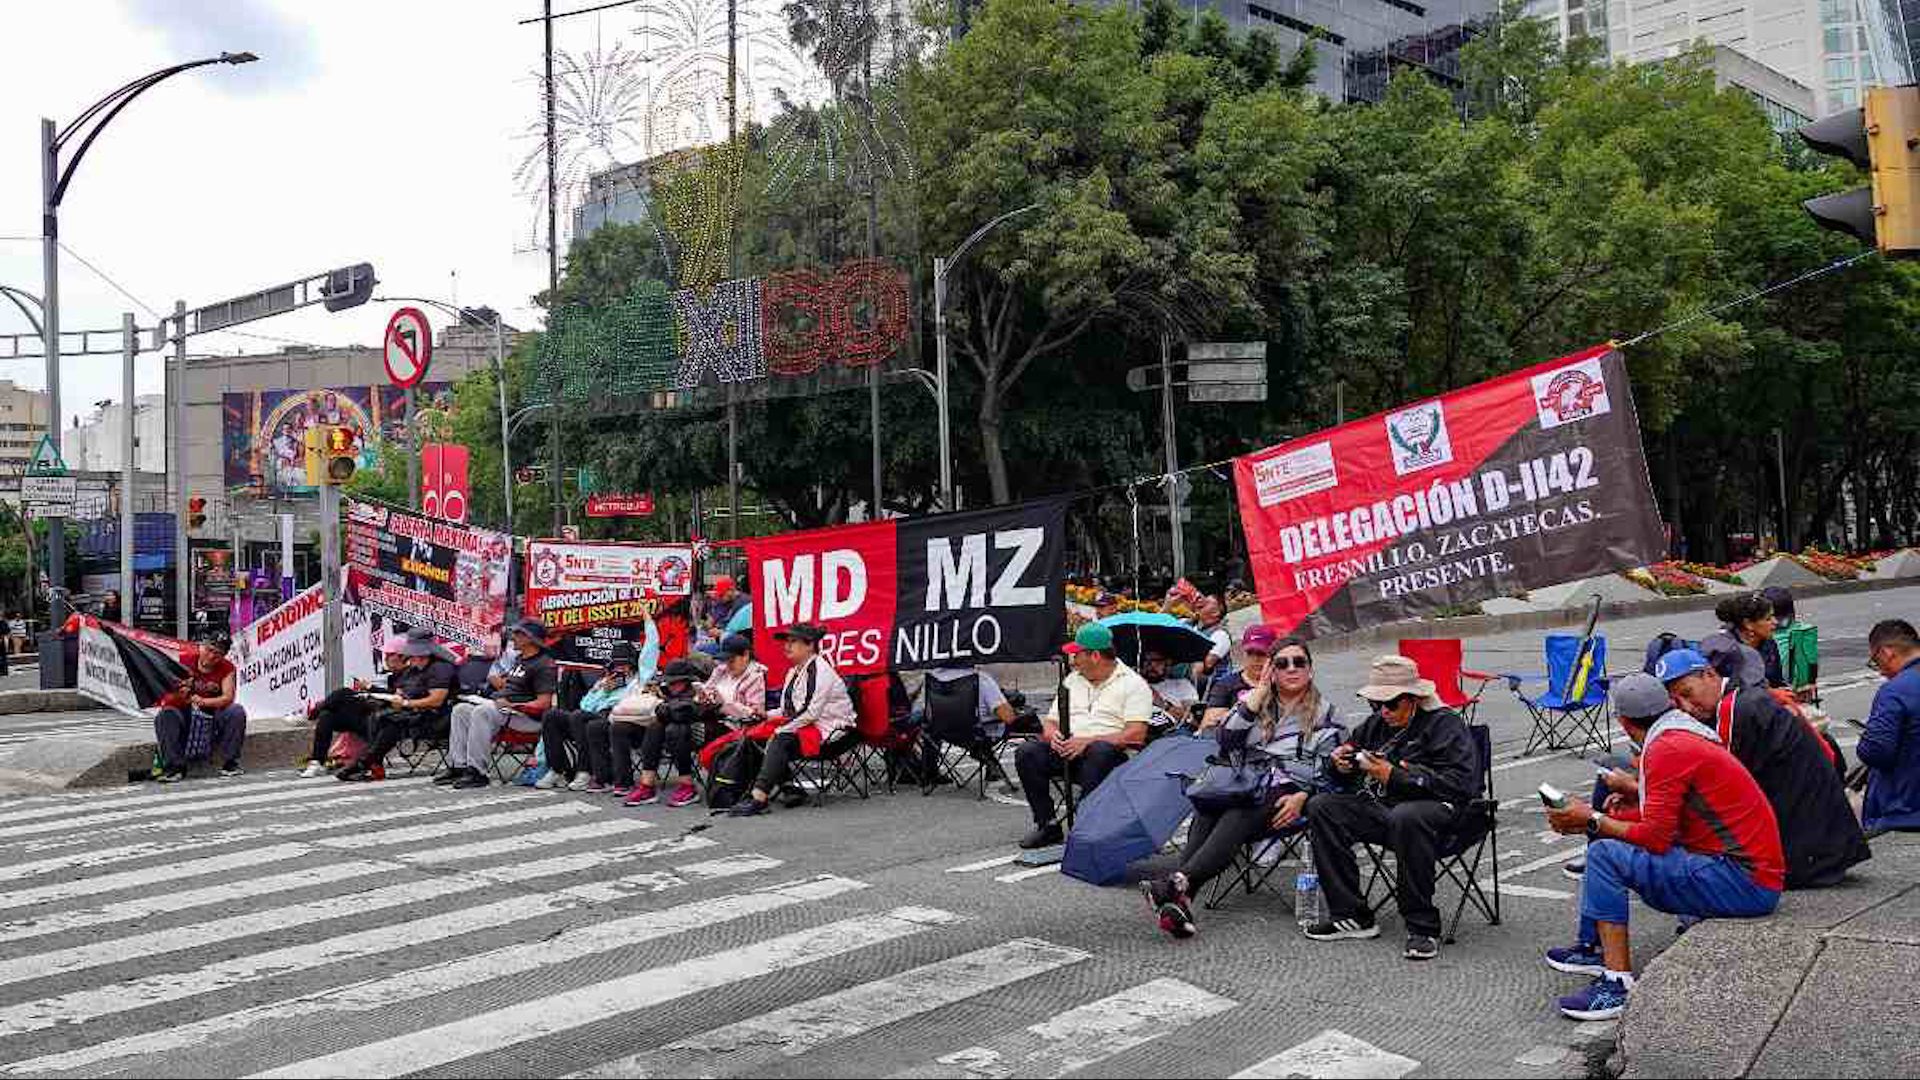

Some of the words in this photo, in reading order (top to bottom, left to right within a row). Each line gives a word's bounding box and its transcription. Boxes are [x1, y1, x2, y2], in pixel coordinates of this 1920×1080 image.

[1280, 479, 1478, 563] DELEGACIÓN
[1294, 540, 1434, 591] FRESNILLO,
[1437, 500, 1601, 556] ZACATECAS.
[762, 549, 868, 628] MD
[925, 527, 1046, 612] MZ
[1380, 552, 1514, 598] PRESENTE.
[563, 608, 587, 626] DEL
[588, 602, 627, 622] ISSSTE
[818, 628, 882, 667] RES
[895, 614, 1001, 664] NILLO
[264, 640, 301, 671] NACIONAL
